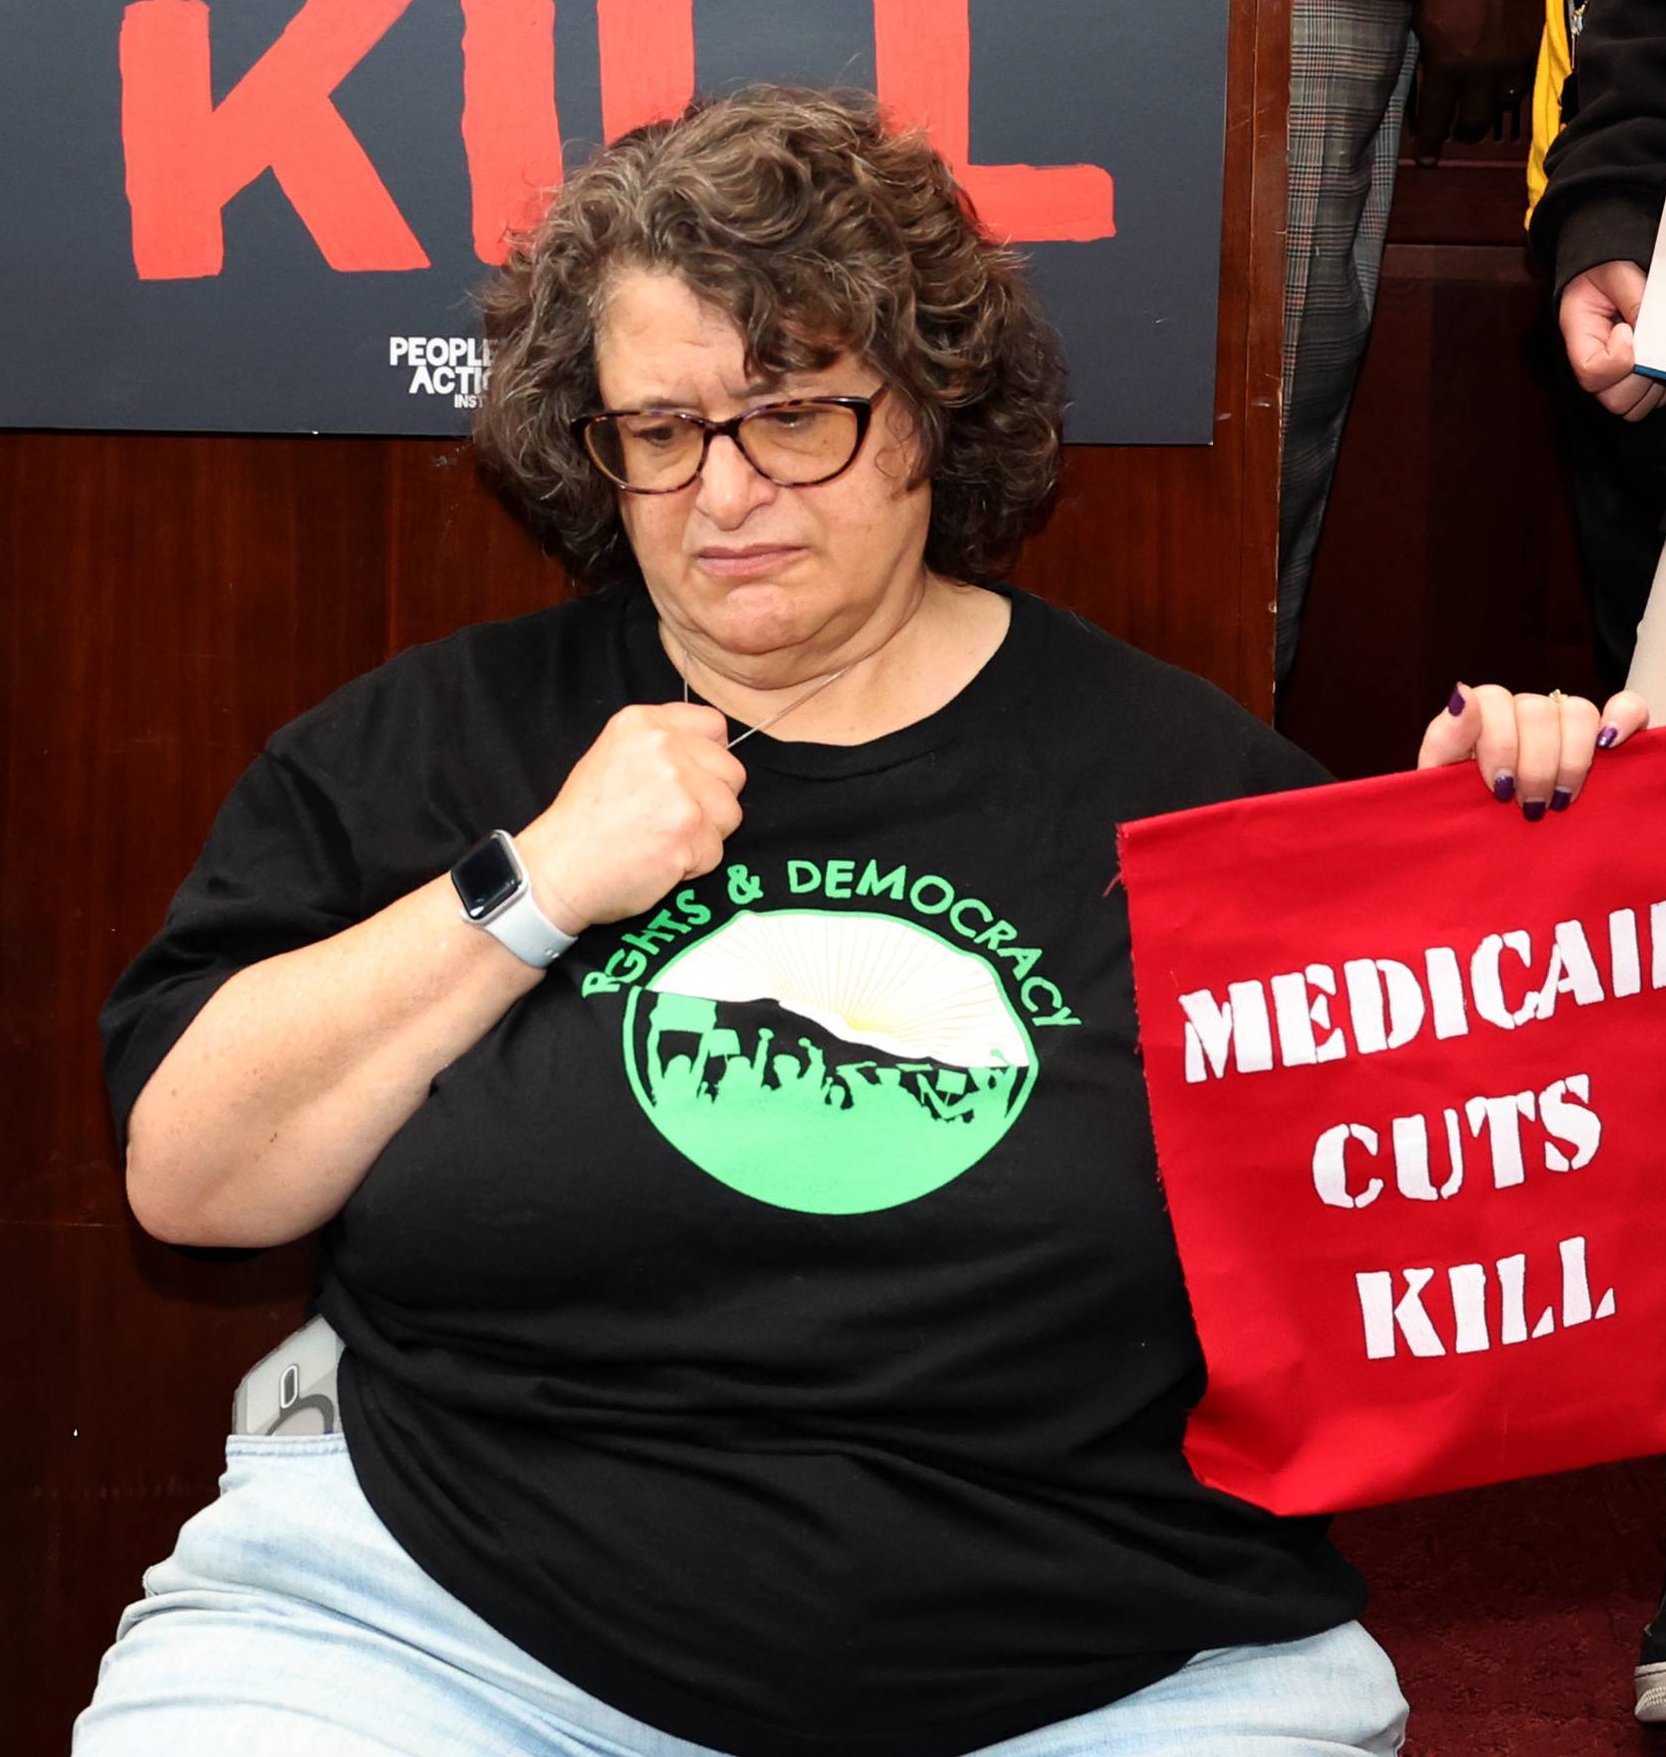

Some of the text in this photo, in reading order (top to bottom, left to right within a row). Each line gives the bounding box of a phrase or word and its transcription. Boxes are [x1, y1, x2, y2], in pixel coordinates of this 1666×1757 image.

[581, 858, 1081, 1028] RGHTS & DEMOCRACY
[1312, 1074, 1601, 1209] CUTS
[1355, 1236, 1616, 1360] KILL
